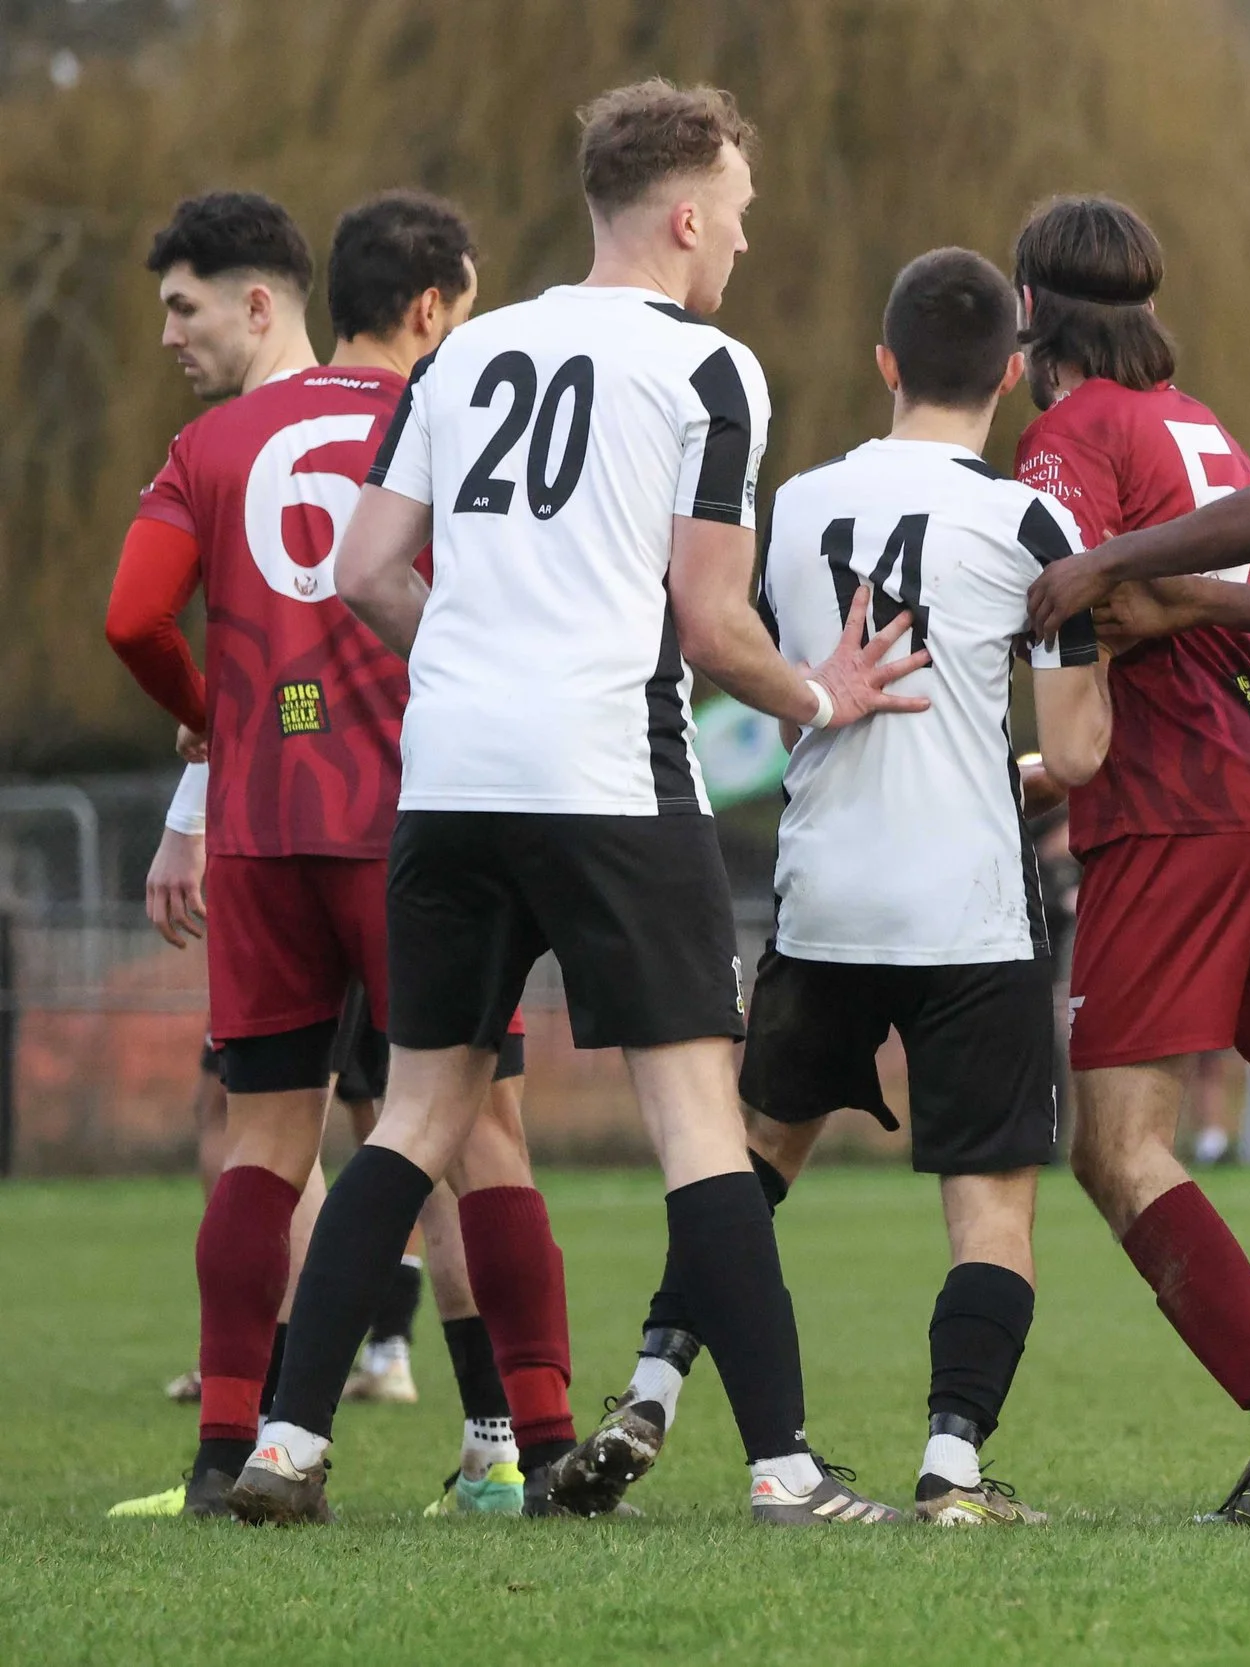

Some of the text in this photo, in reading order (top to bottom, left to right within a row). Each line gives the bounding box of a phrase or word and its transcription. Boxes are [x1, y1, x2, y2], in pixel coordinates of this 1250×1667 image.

[452, 350, 595, 521] 20
[1019, 450, 1063, 474] harles
[244, 414, 376, 604] 6
[473, 497, 490, 507] AR
[538, 504, 552, 514] AR
[820, 513, 933, 668] 14
[283, 684, 320, 701] BIG
[280, 699, 315, 713] YELLOW
[282, 708, 316, 725] SELF
